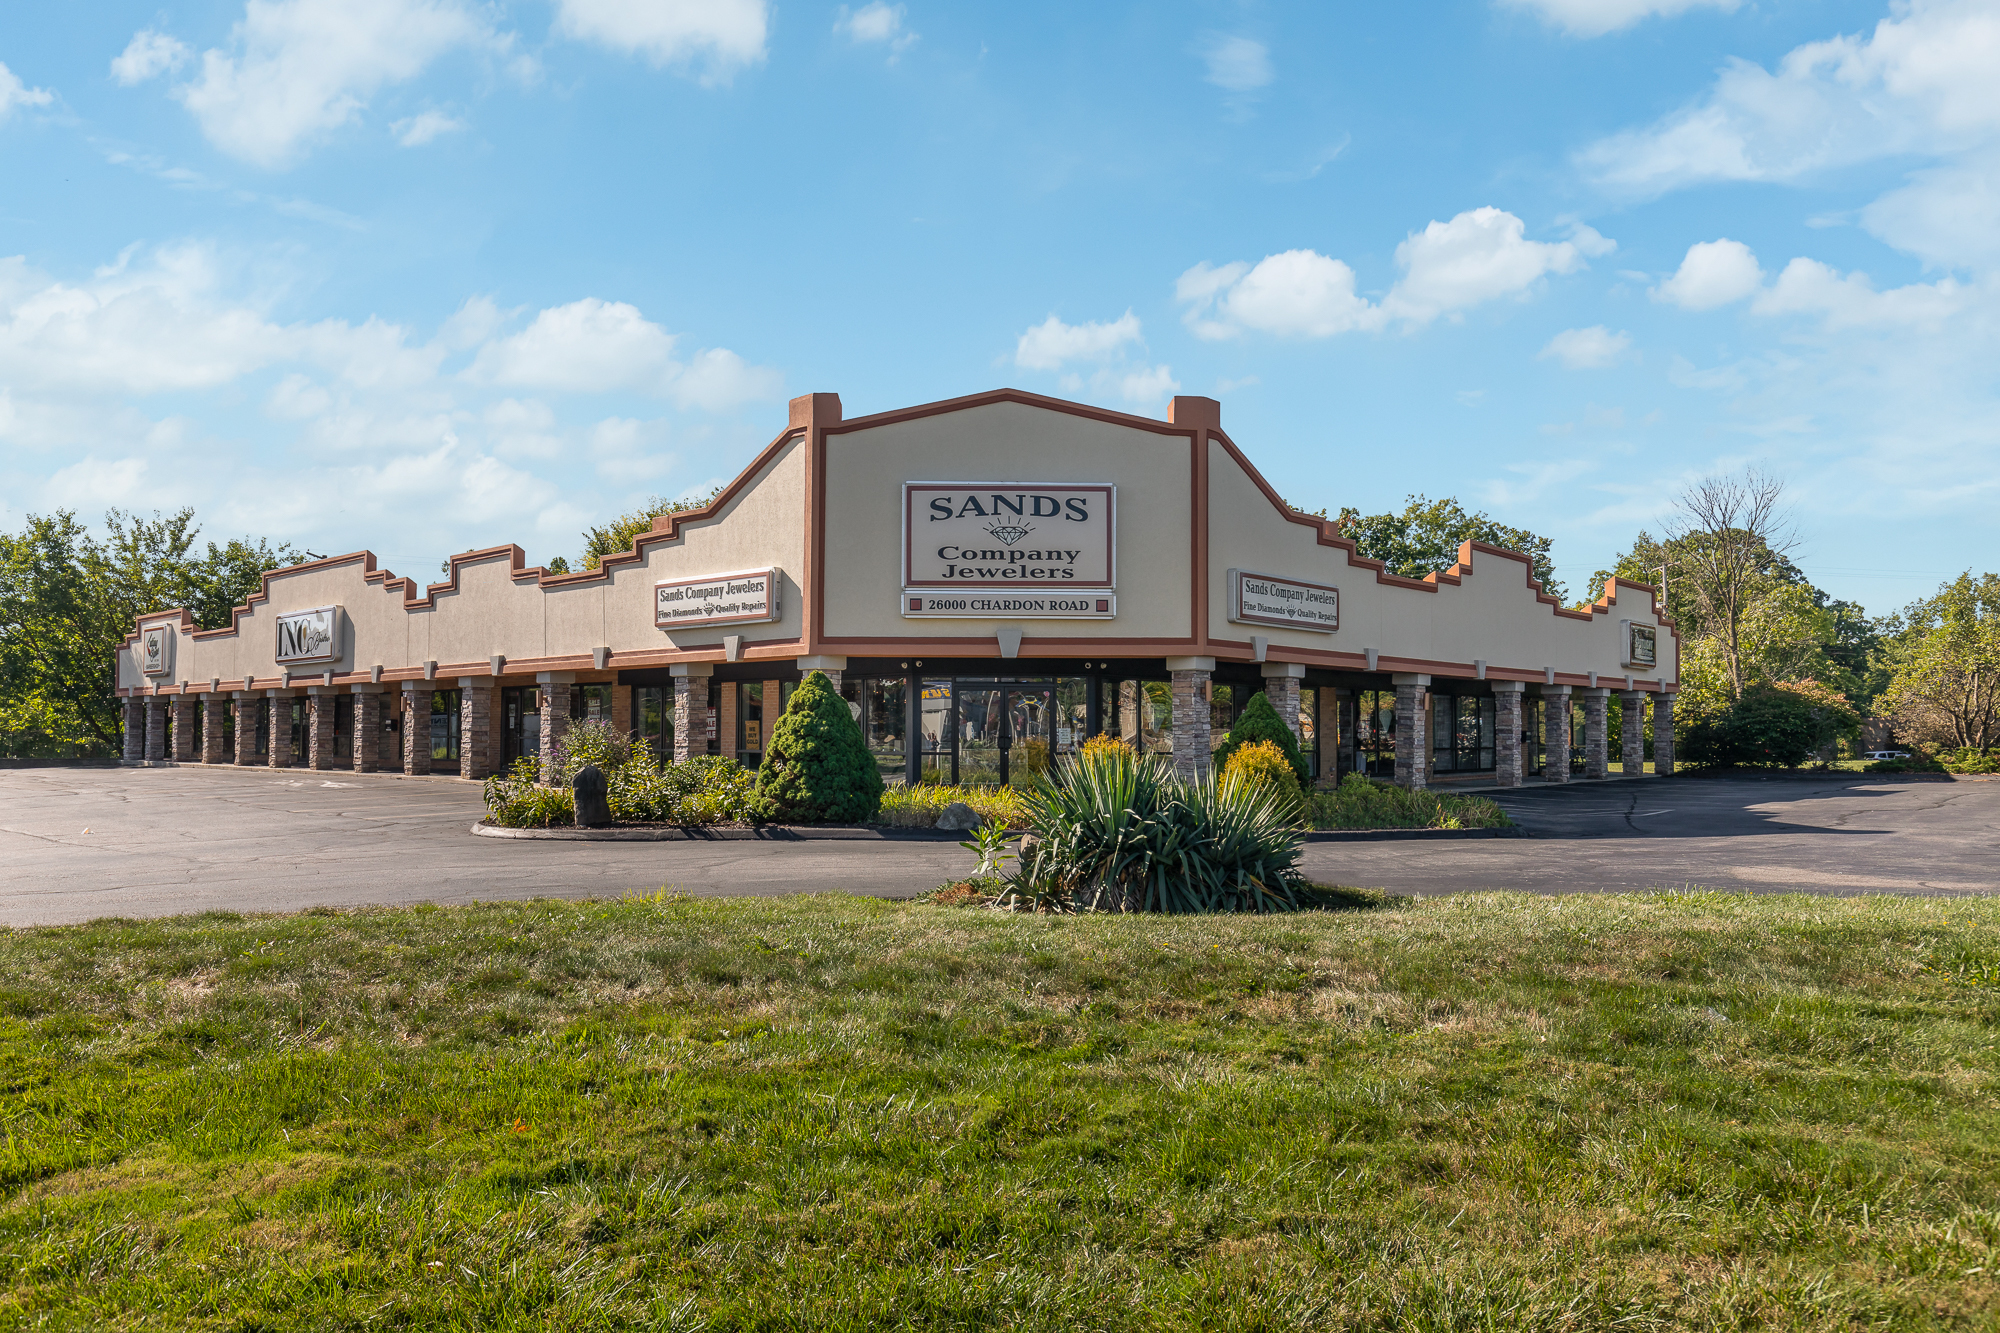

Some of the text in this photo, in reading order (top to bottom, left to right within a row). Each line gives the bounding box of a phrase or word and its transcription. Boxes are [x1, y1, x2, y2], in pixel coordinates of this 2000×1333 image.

[929, 494, 1089, 522] SANDS
[937, 546, 1081, 564] Company
[942, 564, 1074, 579] Jewelers
[660, 580, 765, 603] Sands Company Jewelers
[1245, 579, 1336, 606] Sands Company Jewelers
[658, 601, 767, 619] Fine Diamonds Quality Repairs
[928, 599, 1089, 611] 26000 CHARDON ROAD
[1243, 600, 1338, 622] Fine Diamonds Quality Repairs
